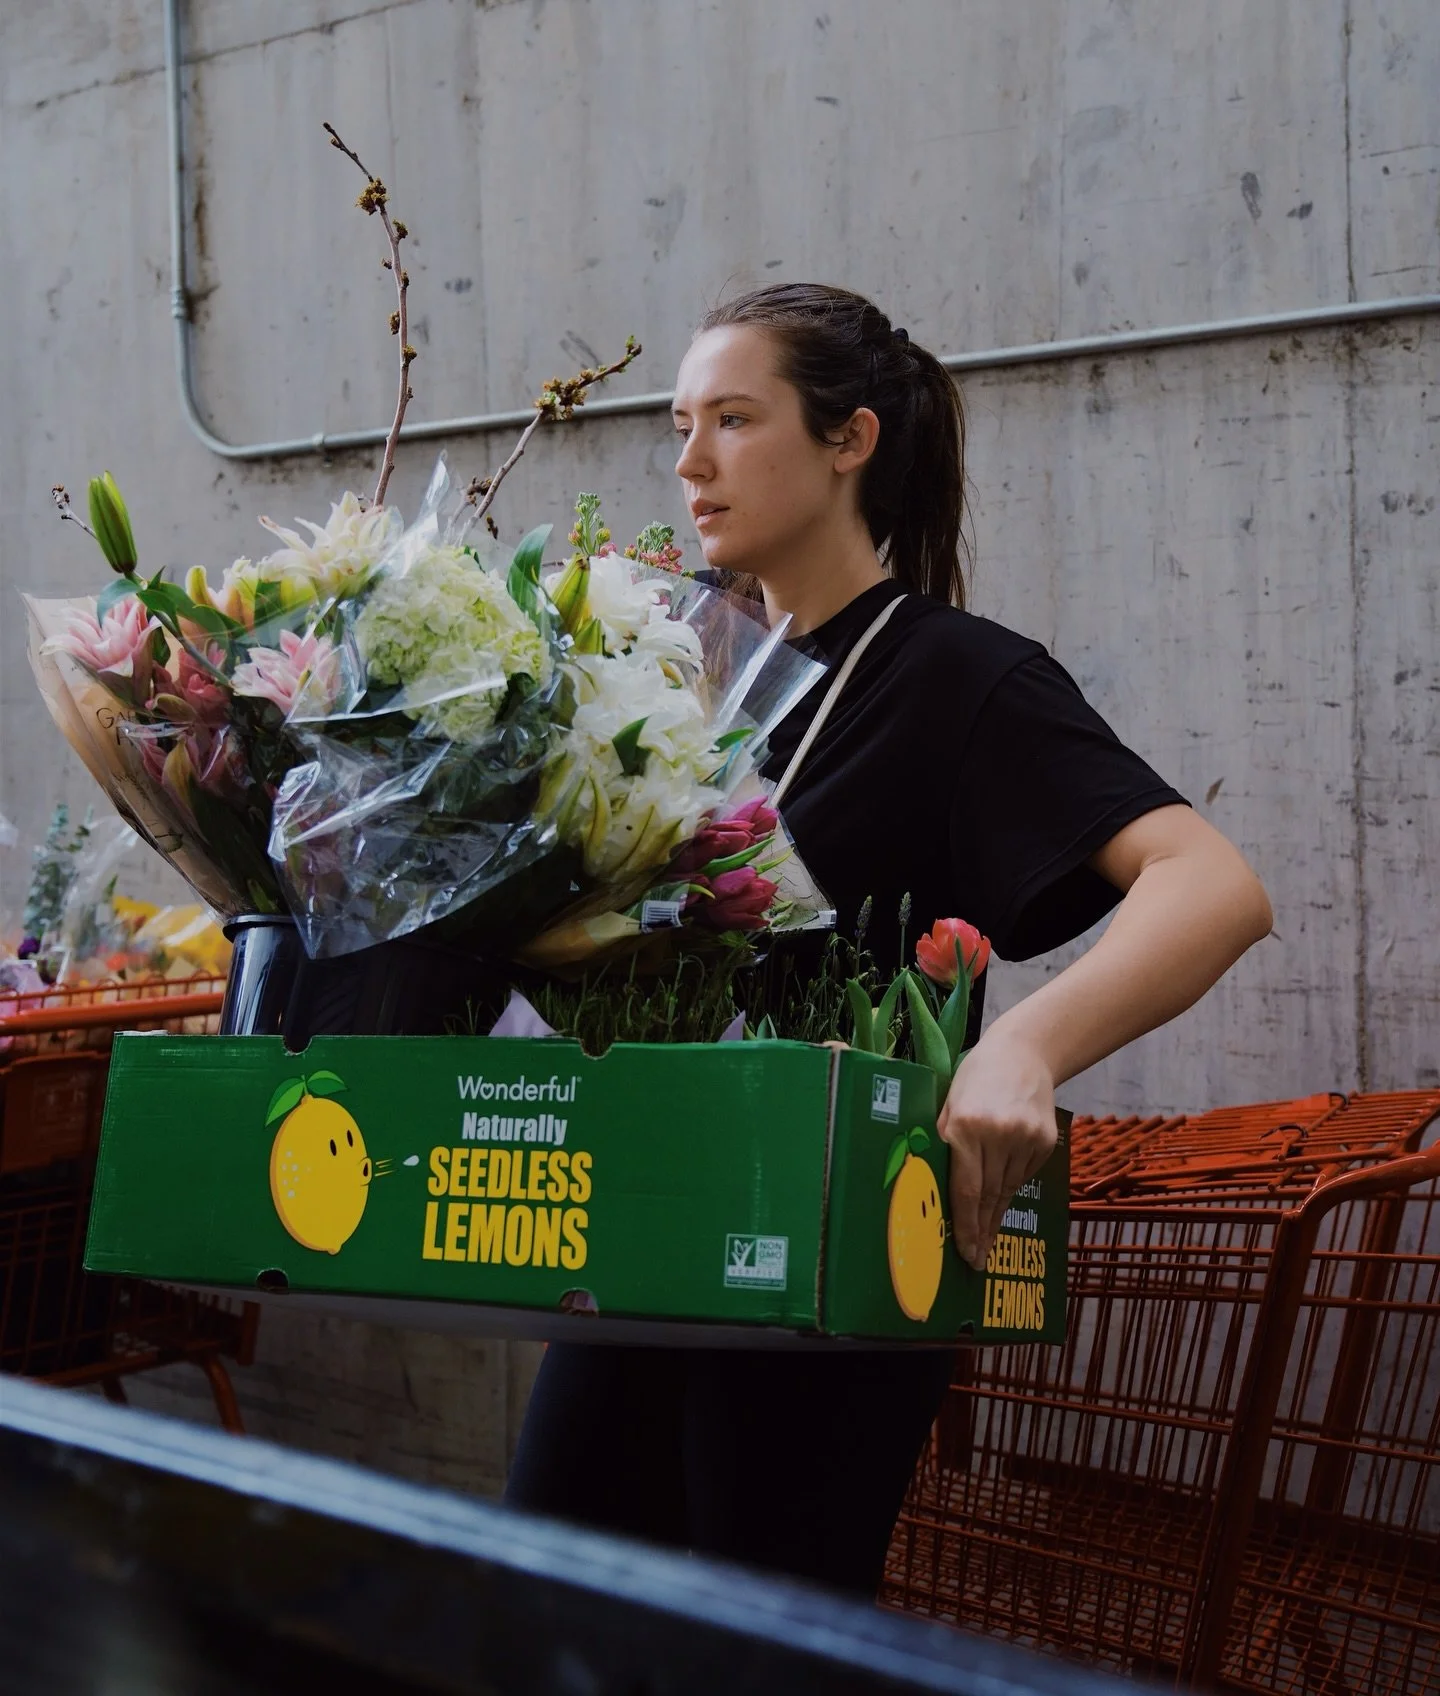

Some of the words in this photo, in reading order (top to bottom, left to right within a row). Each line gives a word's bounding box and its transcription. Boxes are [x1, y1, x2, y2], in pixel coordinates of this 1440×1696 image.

[457, 1075, 577, 1102] Wonderful
[461, 1111, 568, 1146] Naturally
[427, 1146, 593, 1204] SEEDLESS
[1015, 1178, 1042, 1201] derful
[422, 1201, 589, 1271] LEMONS
[759, 1241, 783, 1250] NON
[986, 1233, 1046, 1280] SEEDLESS
[982, 1278, 1046, 1331] LEMONS
